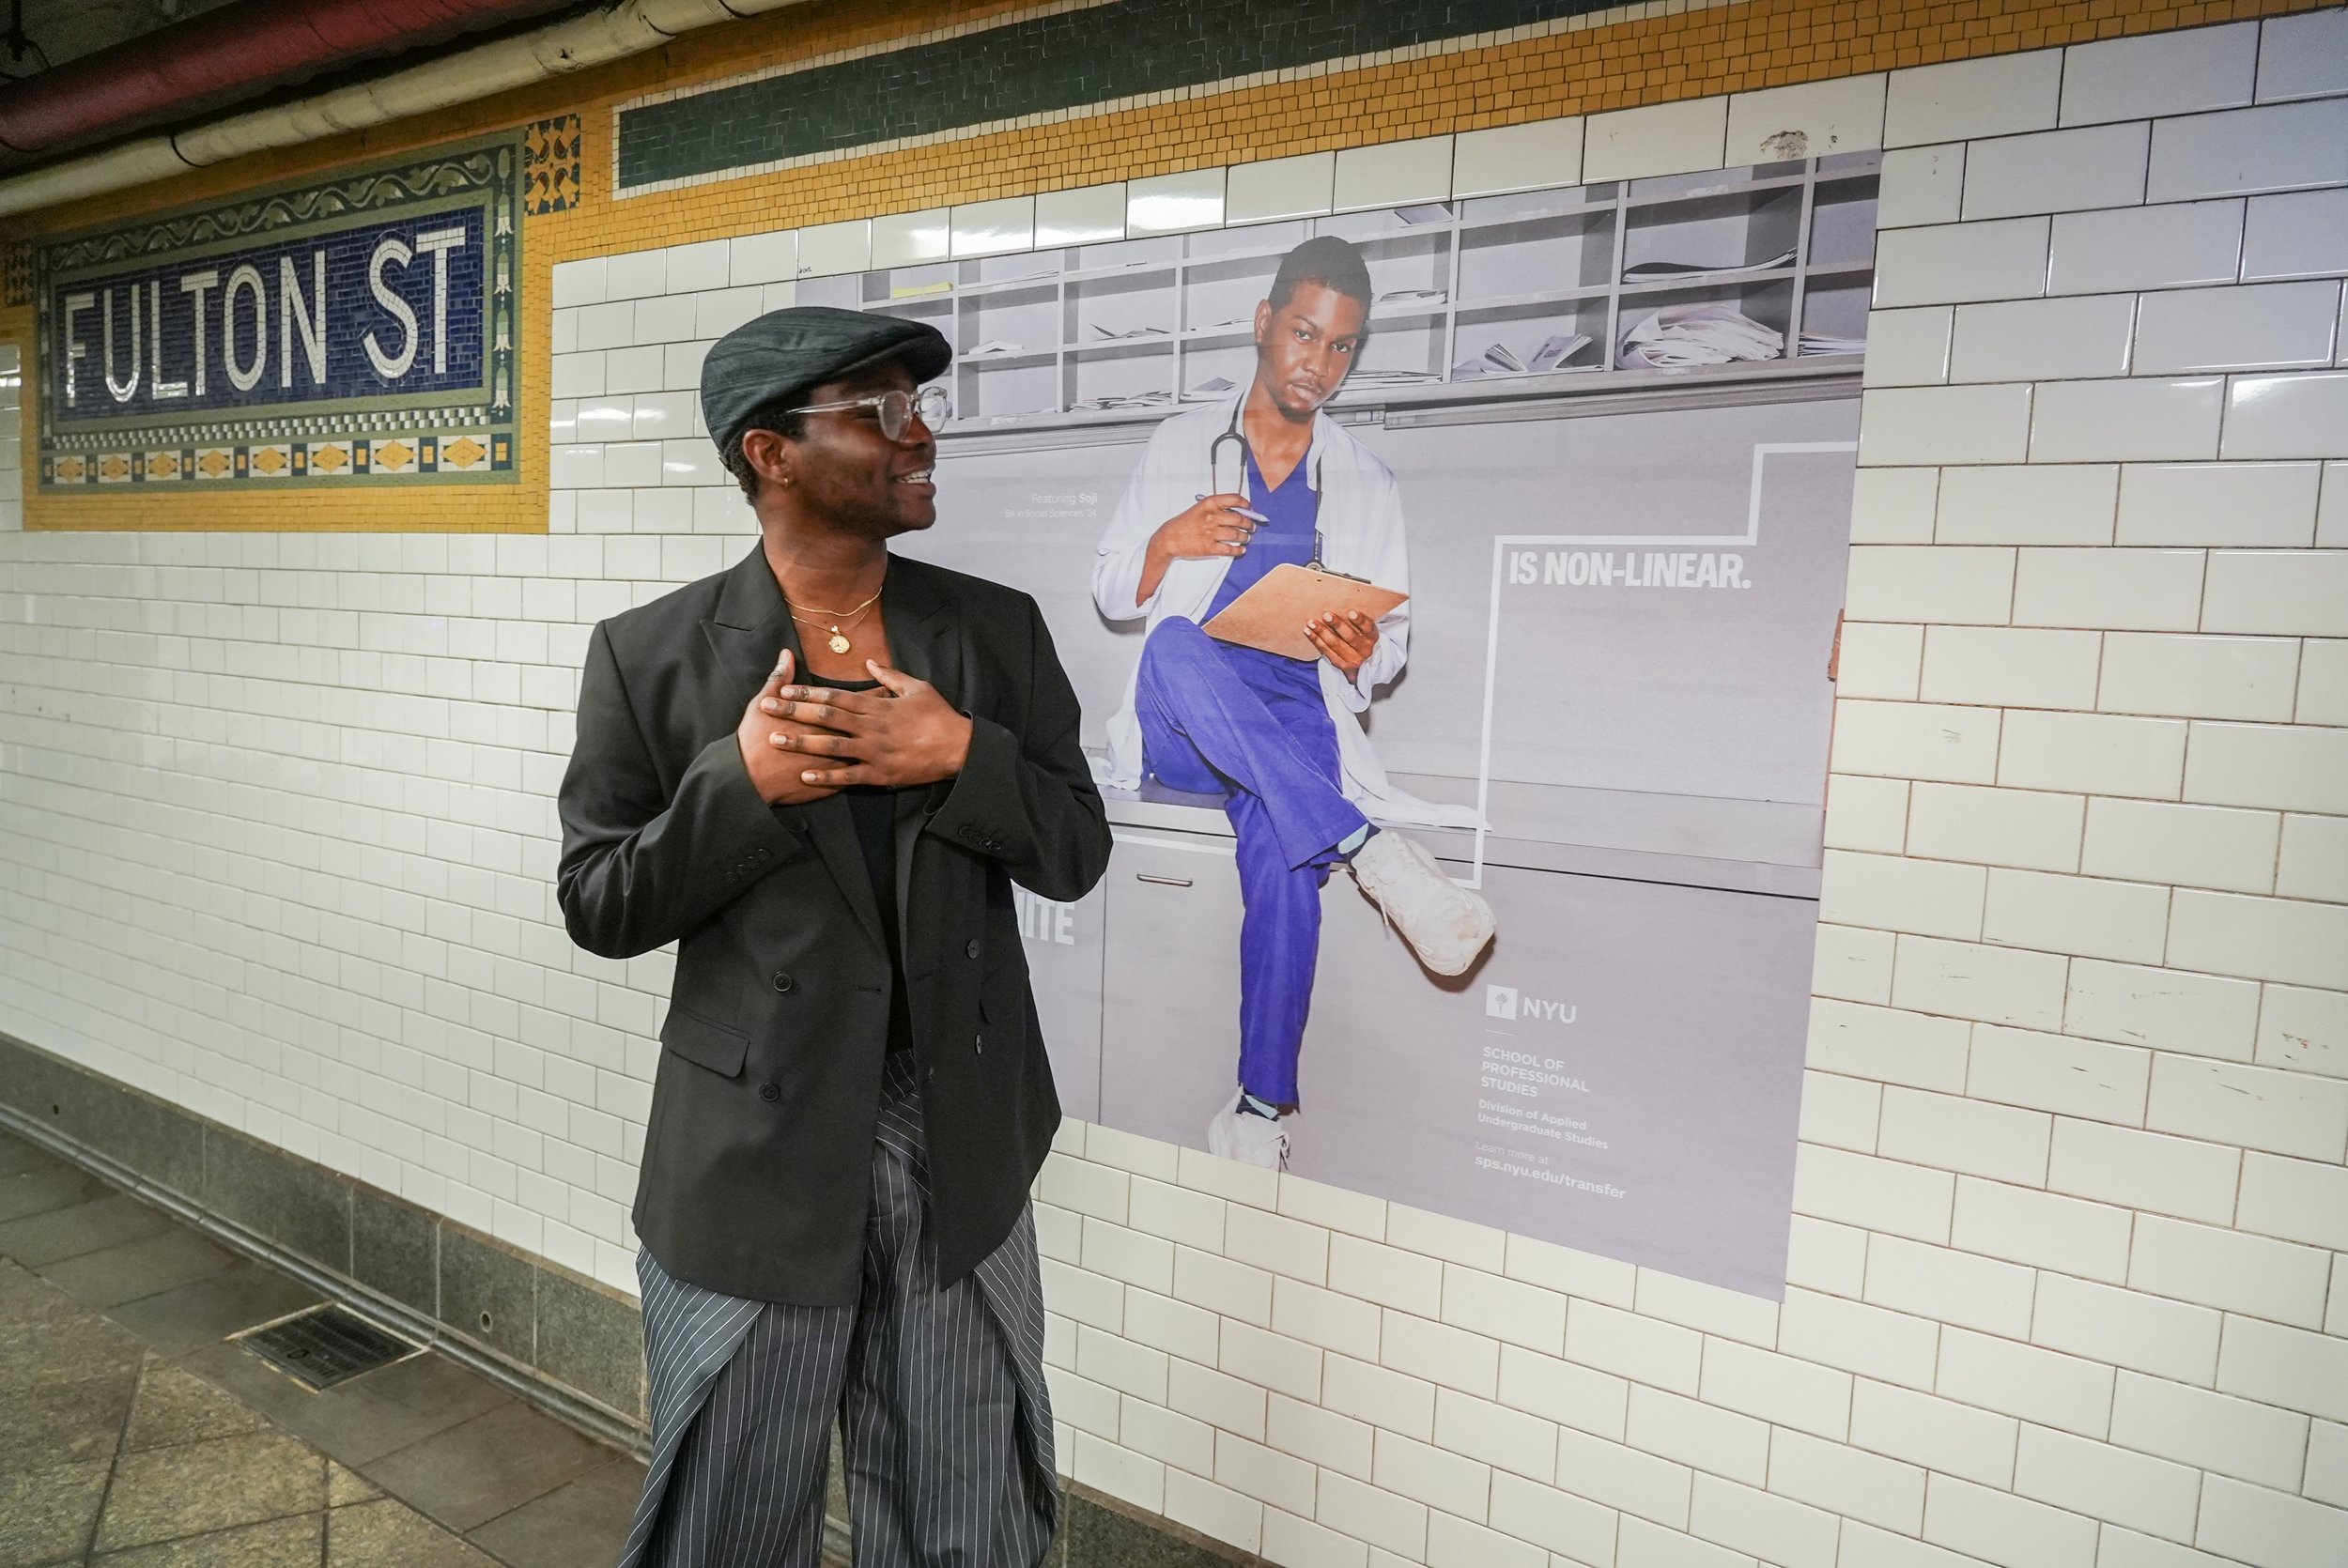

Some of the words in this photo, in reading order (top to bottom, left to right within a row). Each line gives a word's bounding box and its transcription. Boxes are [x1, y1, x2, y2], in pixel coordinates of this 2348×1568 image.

[64, 251, 327, 408] FULTON
[363, 226, 466, 380] ST
[1025, 508, 1047, 518] Social
[1031, 493, 1076, 505] Featuring
[1078, 492, 1098, 505] Soji
[1509, 551, 1538, 585] IS
[1544, 551, 1752, 590] NON-LINEAR.
[1523, 997, 1577, 1024] NYU
[1483, 1046, 1540, 1068] SCHOOL
[1544, 1058, 1565, 1070] OF
[1480, 1076, 1538, 1098] STUDIES
[1481, 1061, 1590, 1093] PROFESSIONAL
[1478, 1099, 1523, 1117] Division
[1526, 1110, 1538, 1120] of
[1541, 1113, 1587, 1130] Applied
[1477, 1113, 1562, 1139] Undergraduate
[1565, 1131, 1609, 1149] Studies
[1475, 1141, 1505, 1156] Learn
[1507, 1150, 1535, 1162] more
[1538, 1156, 1549, 1165] at
[1475, 1156, 1627, 1199] sps.nyu.edu/transfer
